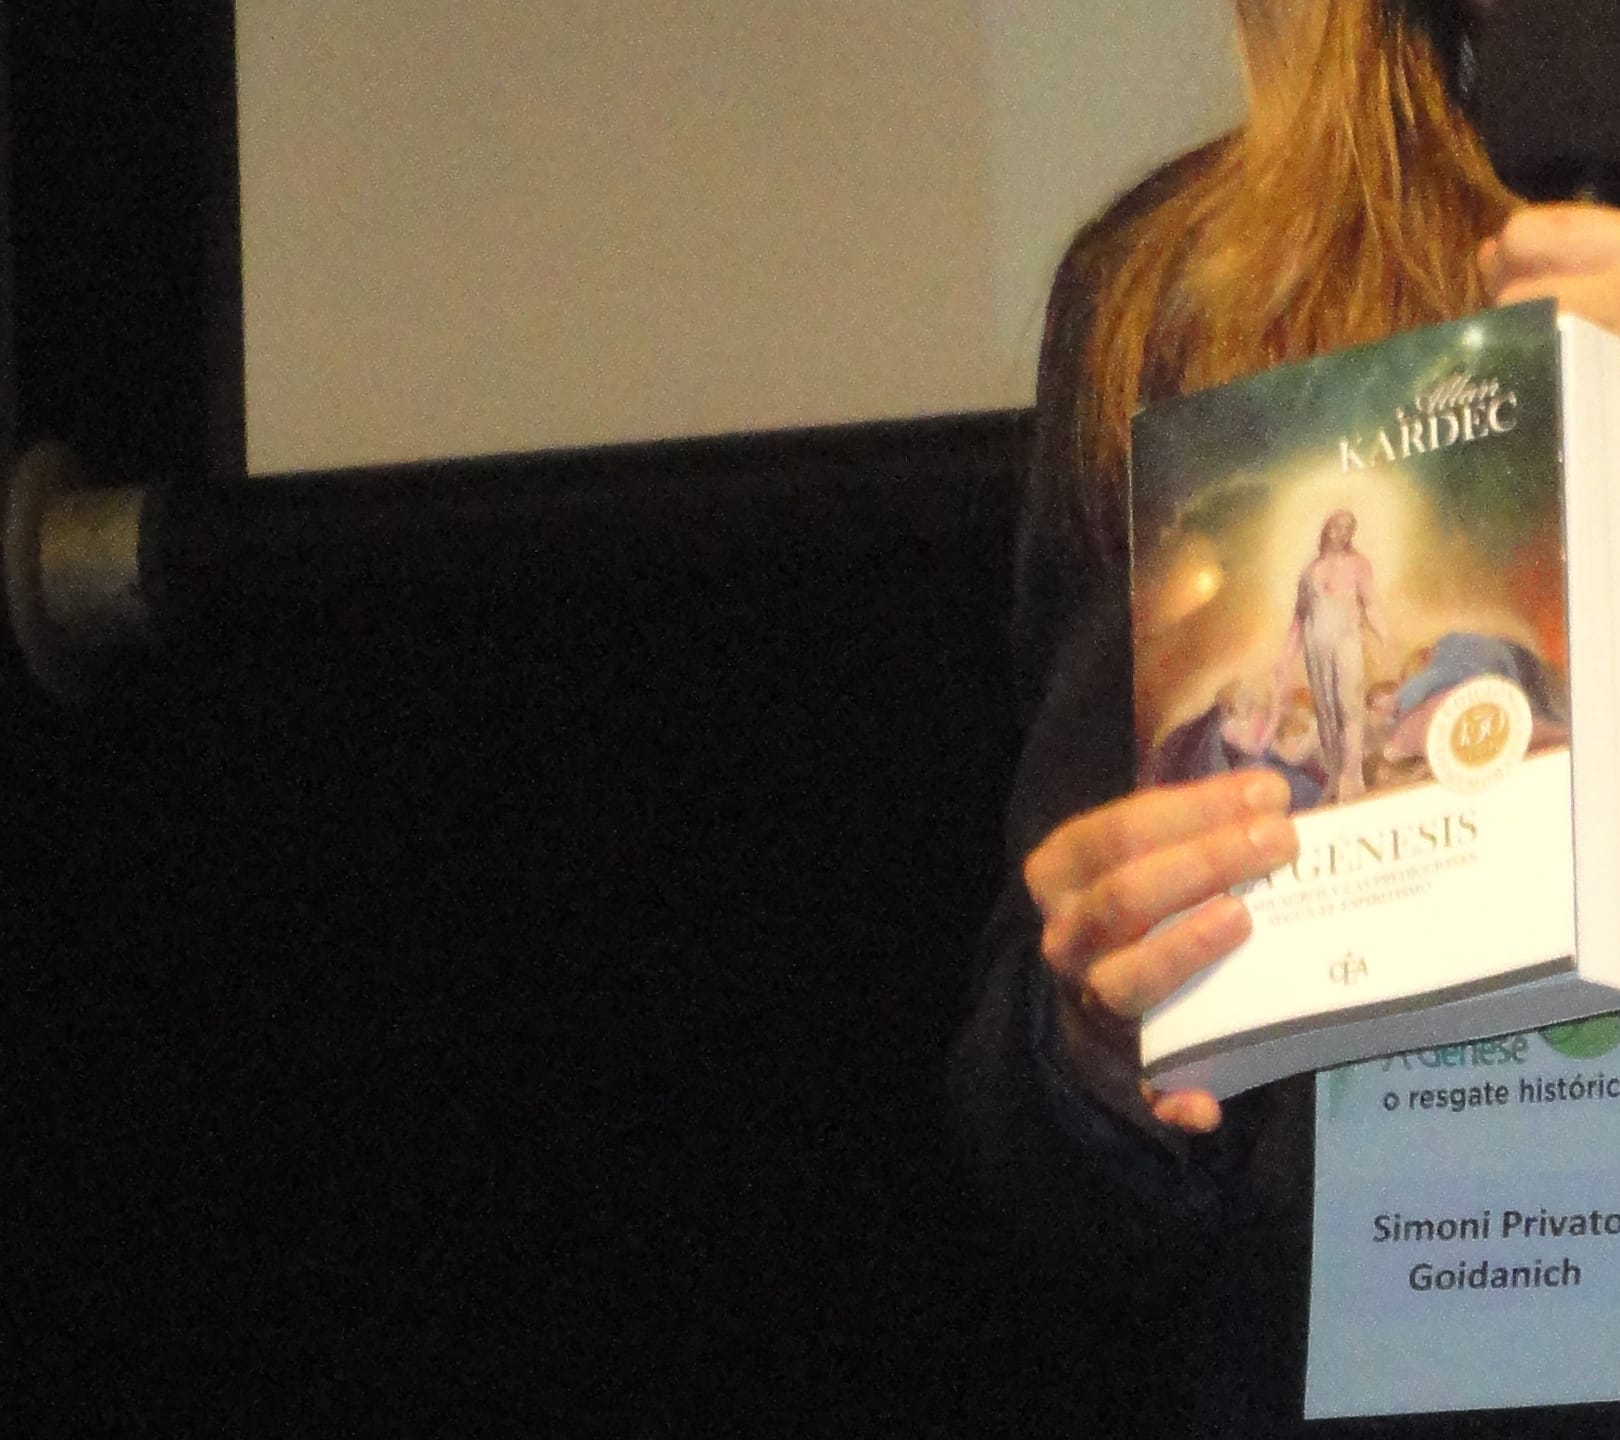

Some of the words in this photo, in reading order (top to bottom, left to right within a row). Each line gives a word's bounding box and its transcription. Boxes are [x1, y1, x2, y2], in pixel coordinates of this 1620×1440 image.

[1339, 391, 1518, 473] KARDEC
[1383, 1091, 1400, 1112] o
[1408, 1080, 1510, 1113] resgate
[1373, 1210, 1491, 1243] Simoni
[1408, 1257, 1582, 1293] Goidanich
